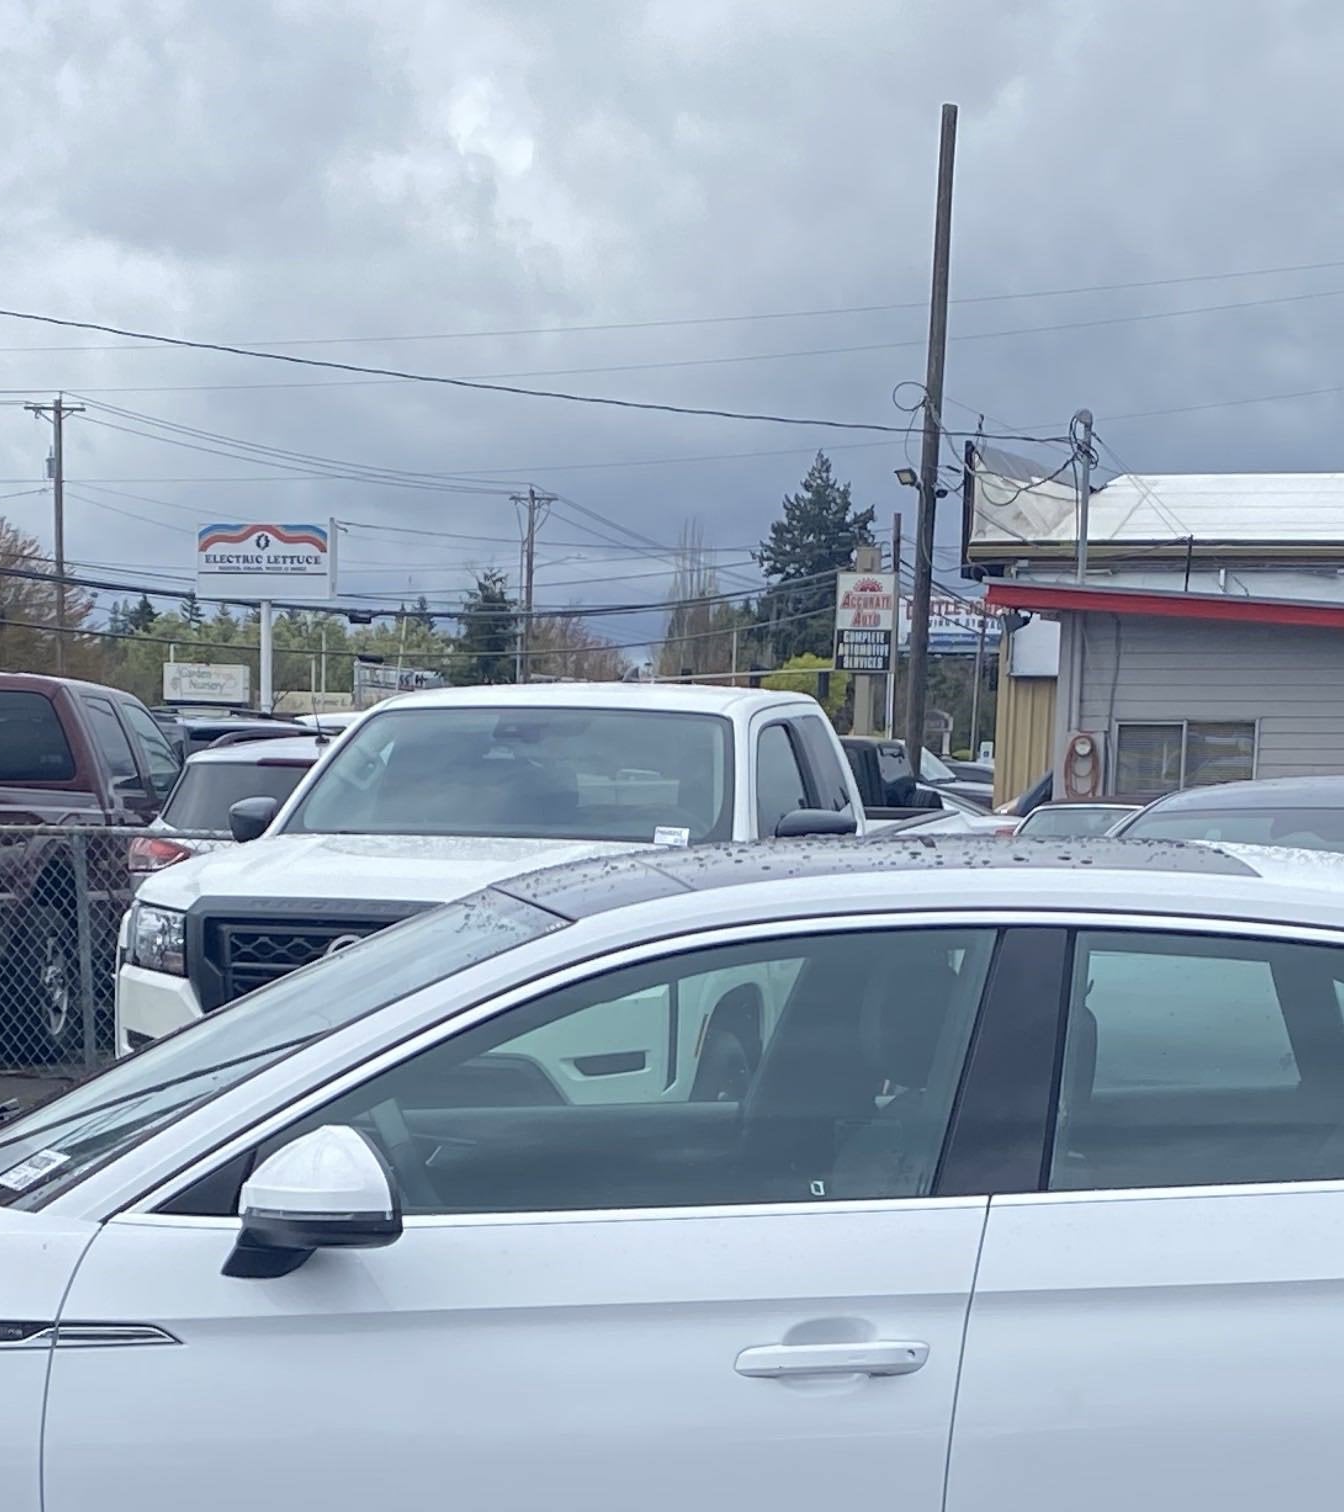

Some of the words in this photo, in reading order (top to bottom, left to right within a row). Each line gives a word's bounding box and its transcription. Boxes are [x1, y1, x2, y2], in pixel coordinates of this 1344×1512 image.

[204, 554, 264, 564] ELECTRIC
[267, 555, 322, 565] LETTUCE
[840, 591, 892, 610] ACCURATE
[852, 611, 881, 627] AUTO
[843, 631, 885, 643] COMPLETE
[838, 643, 889, 656] AUTOMOTIVE
[843, 657, 884, 669] SERVICES
